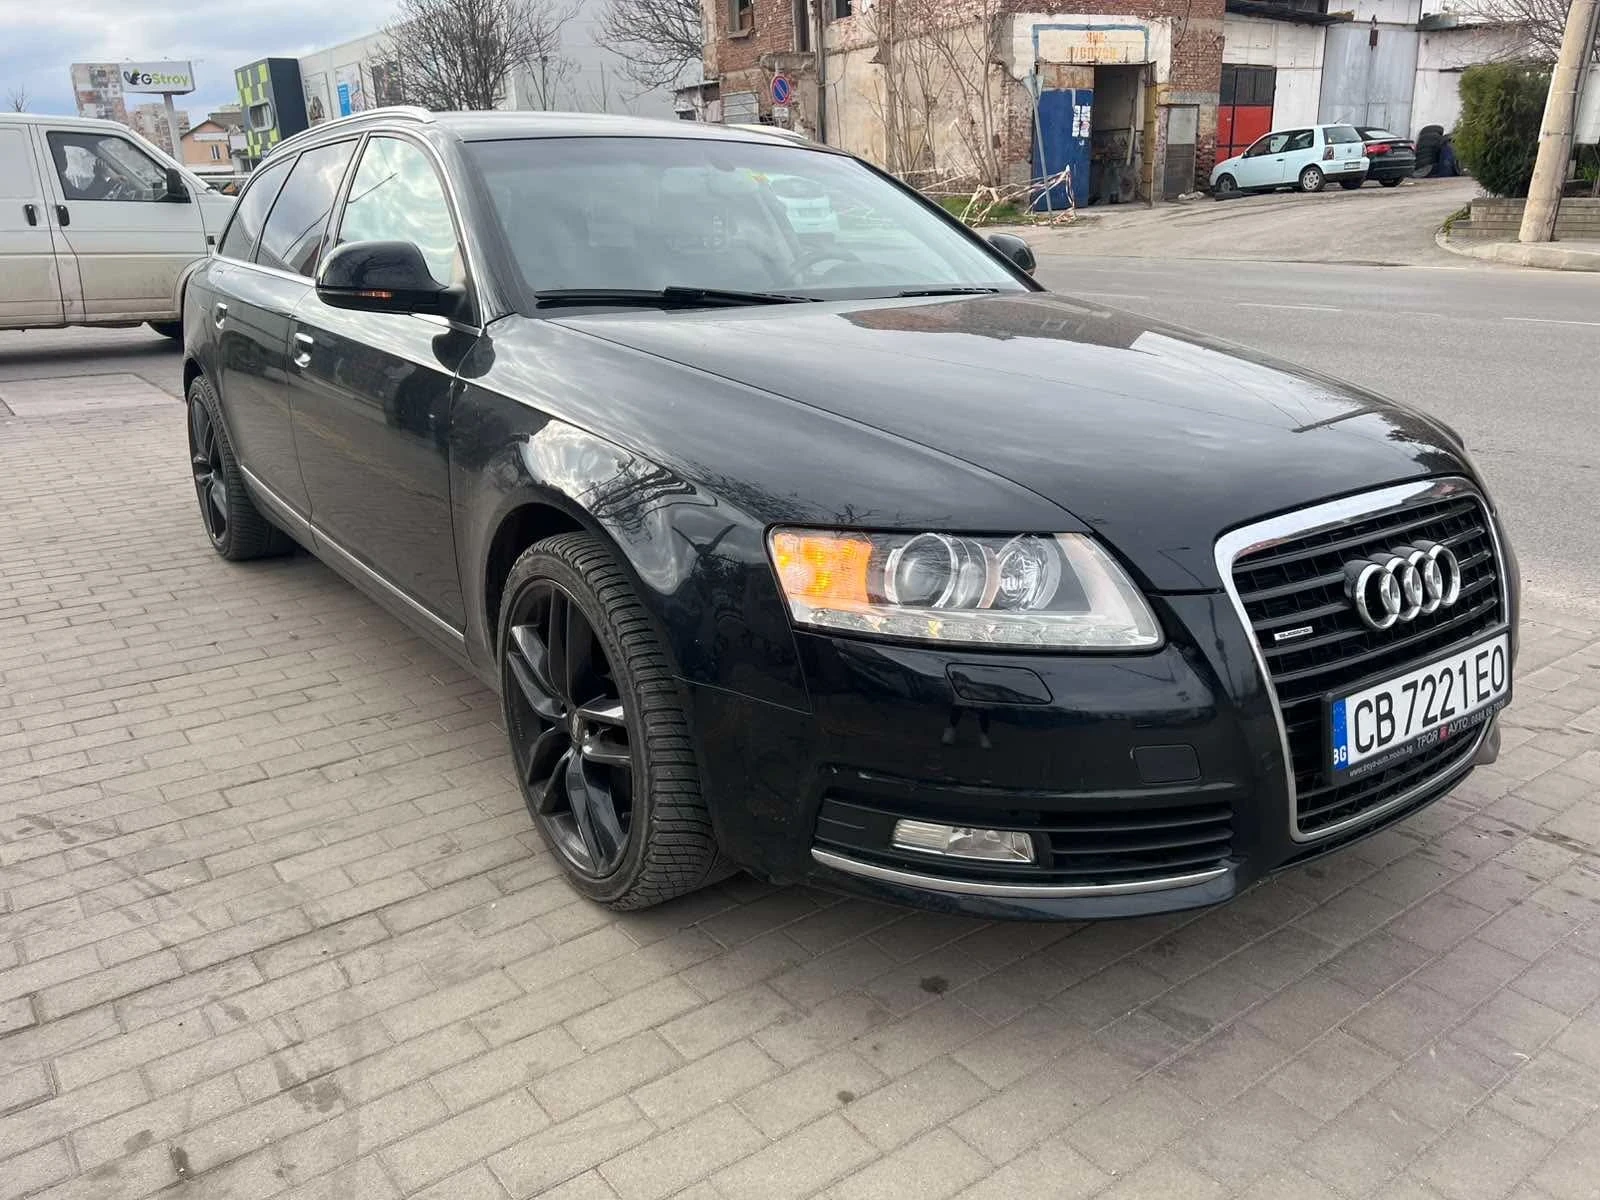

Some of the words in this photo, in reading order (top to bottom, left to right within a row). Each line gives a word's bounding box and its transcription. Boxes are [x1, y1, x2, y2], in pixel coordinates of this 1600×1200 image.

[1354, 691, 1395, 753] CB
[1402, 660, 1468, 736] 7221
[1476, 645, 1505, 702] EO
[1333, 745, 1347, 765] BG
